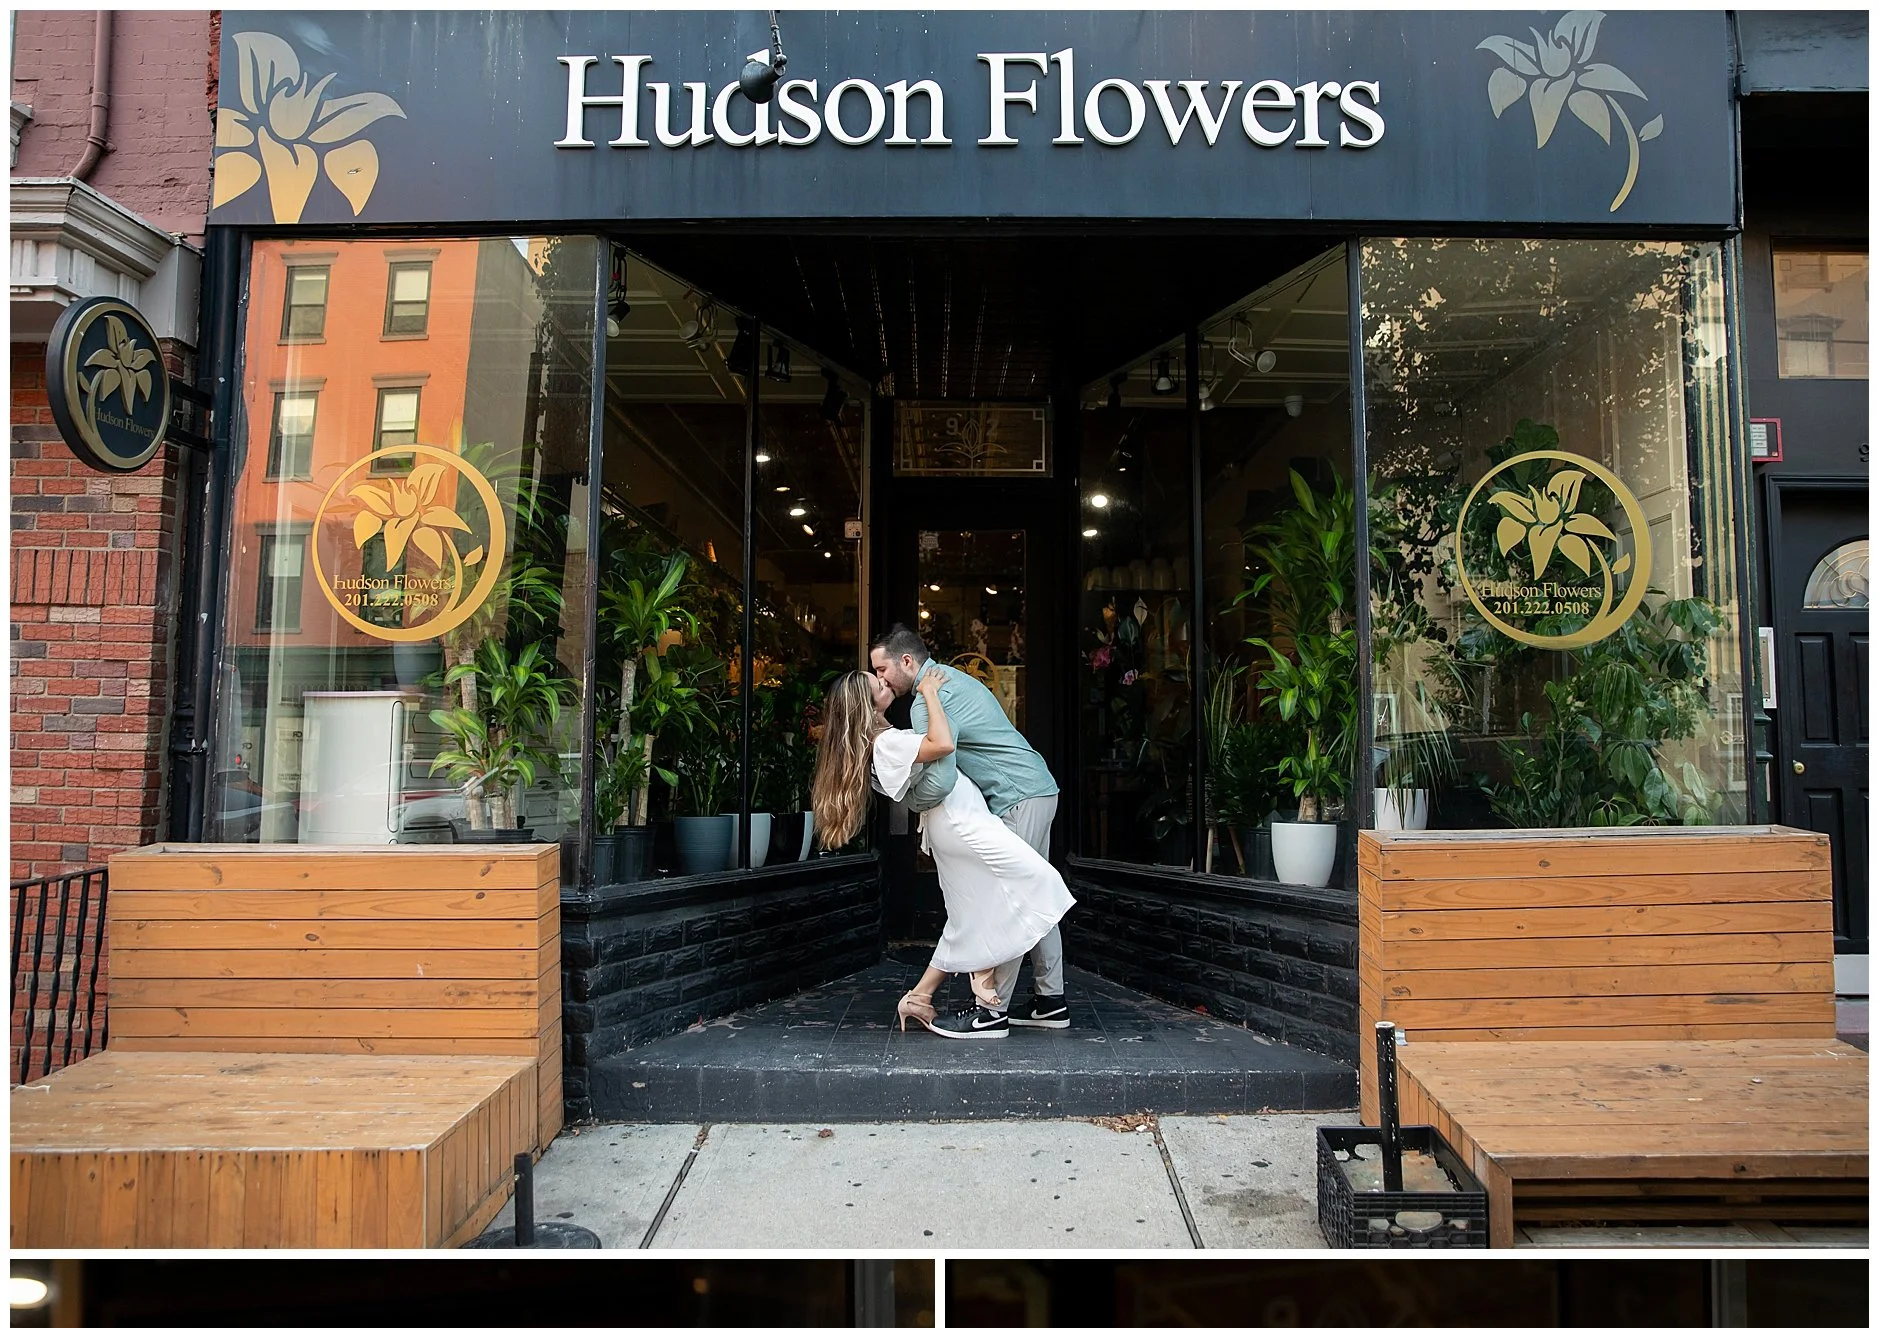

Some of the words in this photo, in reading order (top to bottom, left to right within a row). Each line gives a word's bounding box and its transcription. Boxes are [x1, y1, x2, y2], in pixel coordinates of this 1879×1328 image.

[553, 48, 953, 148] Hudson
[976, 47, 1386, 148] Flowers
[125, 417, 155, 440] Flowers
[333, 574, 390, 590] Hudson
[393, 574, 451, 590] Flowers
[1481, 582, 1540, 598] Hudson
[1542, 582, 1602, 598] Flowers
[344, 593, 439, 607] 201.222.0508
[1493, 601, 1590, 615] 201.222.0508
